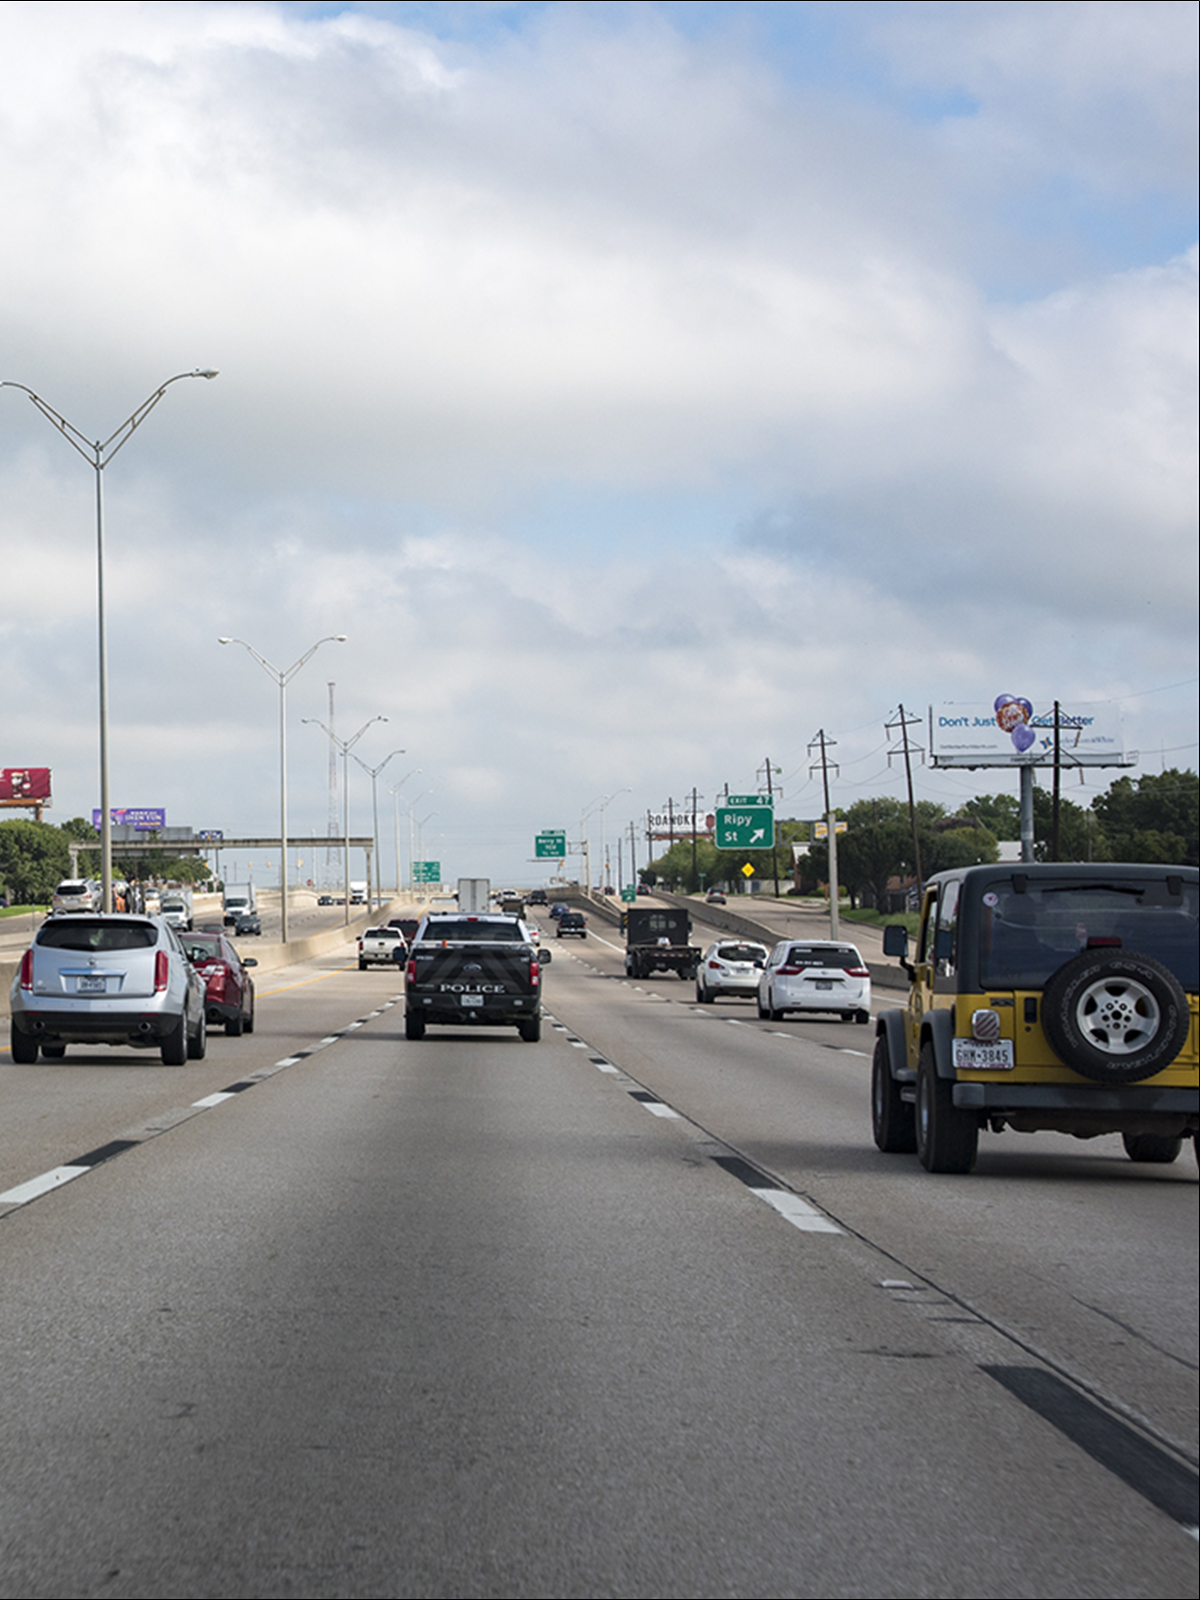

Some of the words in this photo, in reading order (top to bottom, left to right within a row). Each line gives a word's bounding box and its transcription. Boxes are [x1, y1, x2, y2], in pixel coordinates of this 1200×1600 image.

[939, 716, 969, 727] Don't
[972, 716, 996, 727] Just
[756, 796, 770, 804] 47
[649, 814, 696, 826] ROANOK
[724, 814, 752, 827] Ripy
[725, 831, 738, 841] St
[440, 983, 505, 993] POLICE
